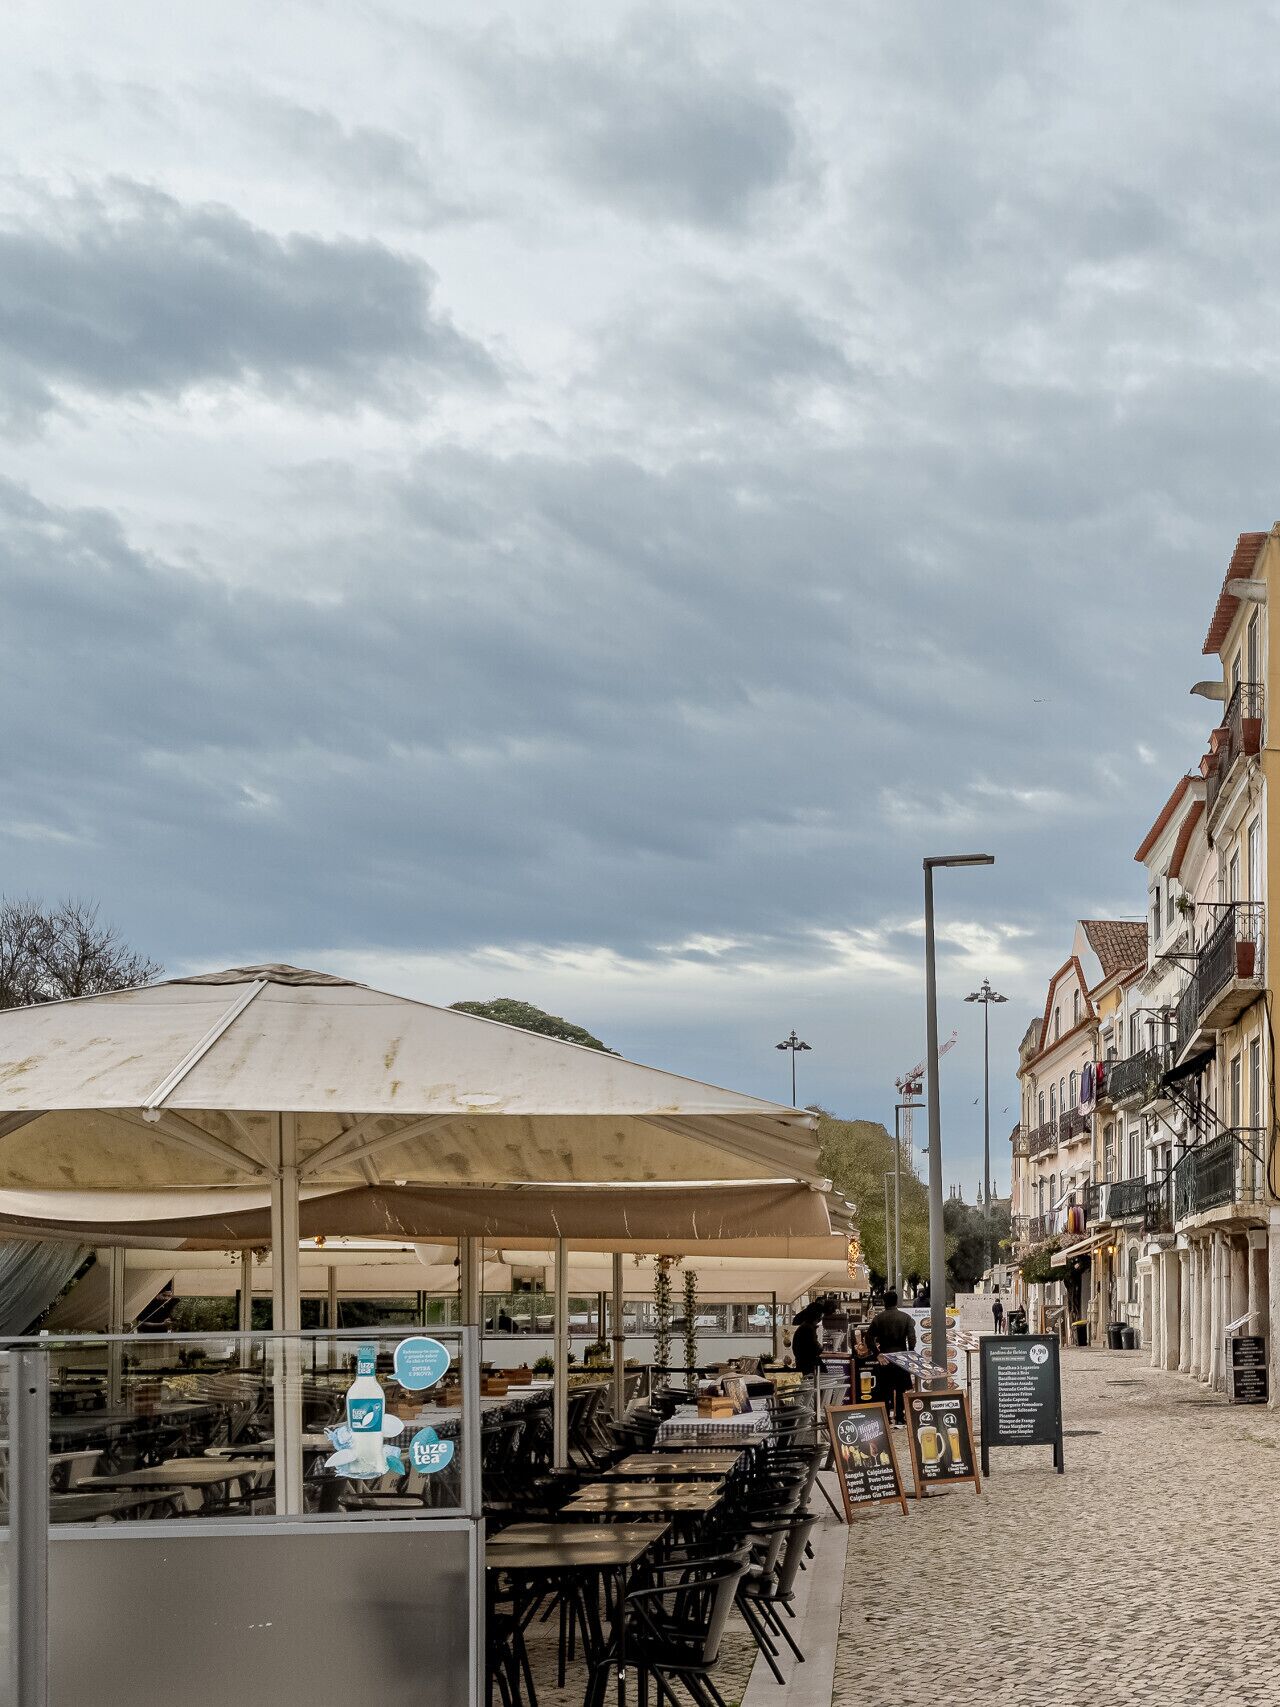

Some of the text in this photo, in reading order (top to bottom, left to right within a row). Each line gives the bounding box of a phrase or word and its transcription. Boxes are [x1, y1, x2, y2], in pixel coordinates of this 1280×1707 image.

[358, 1361, 375, 1369] fuze
[840, 1424, 855, 1435] 3,90
[413, 1442, 447, 1454] fuze
[414, 1453, 440, 1465] tea
